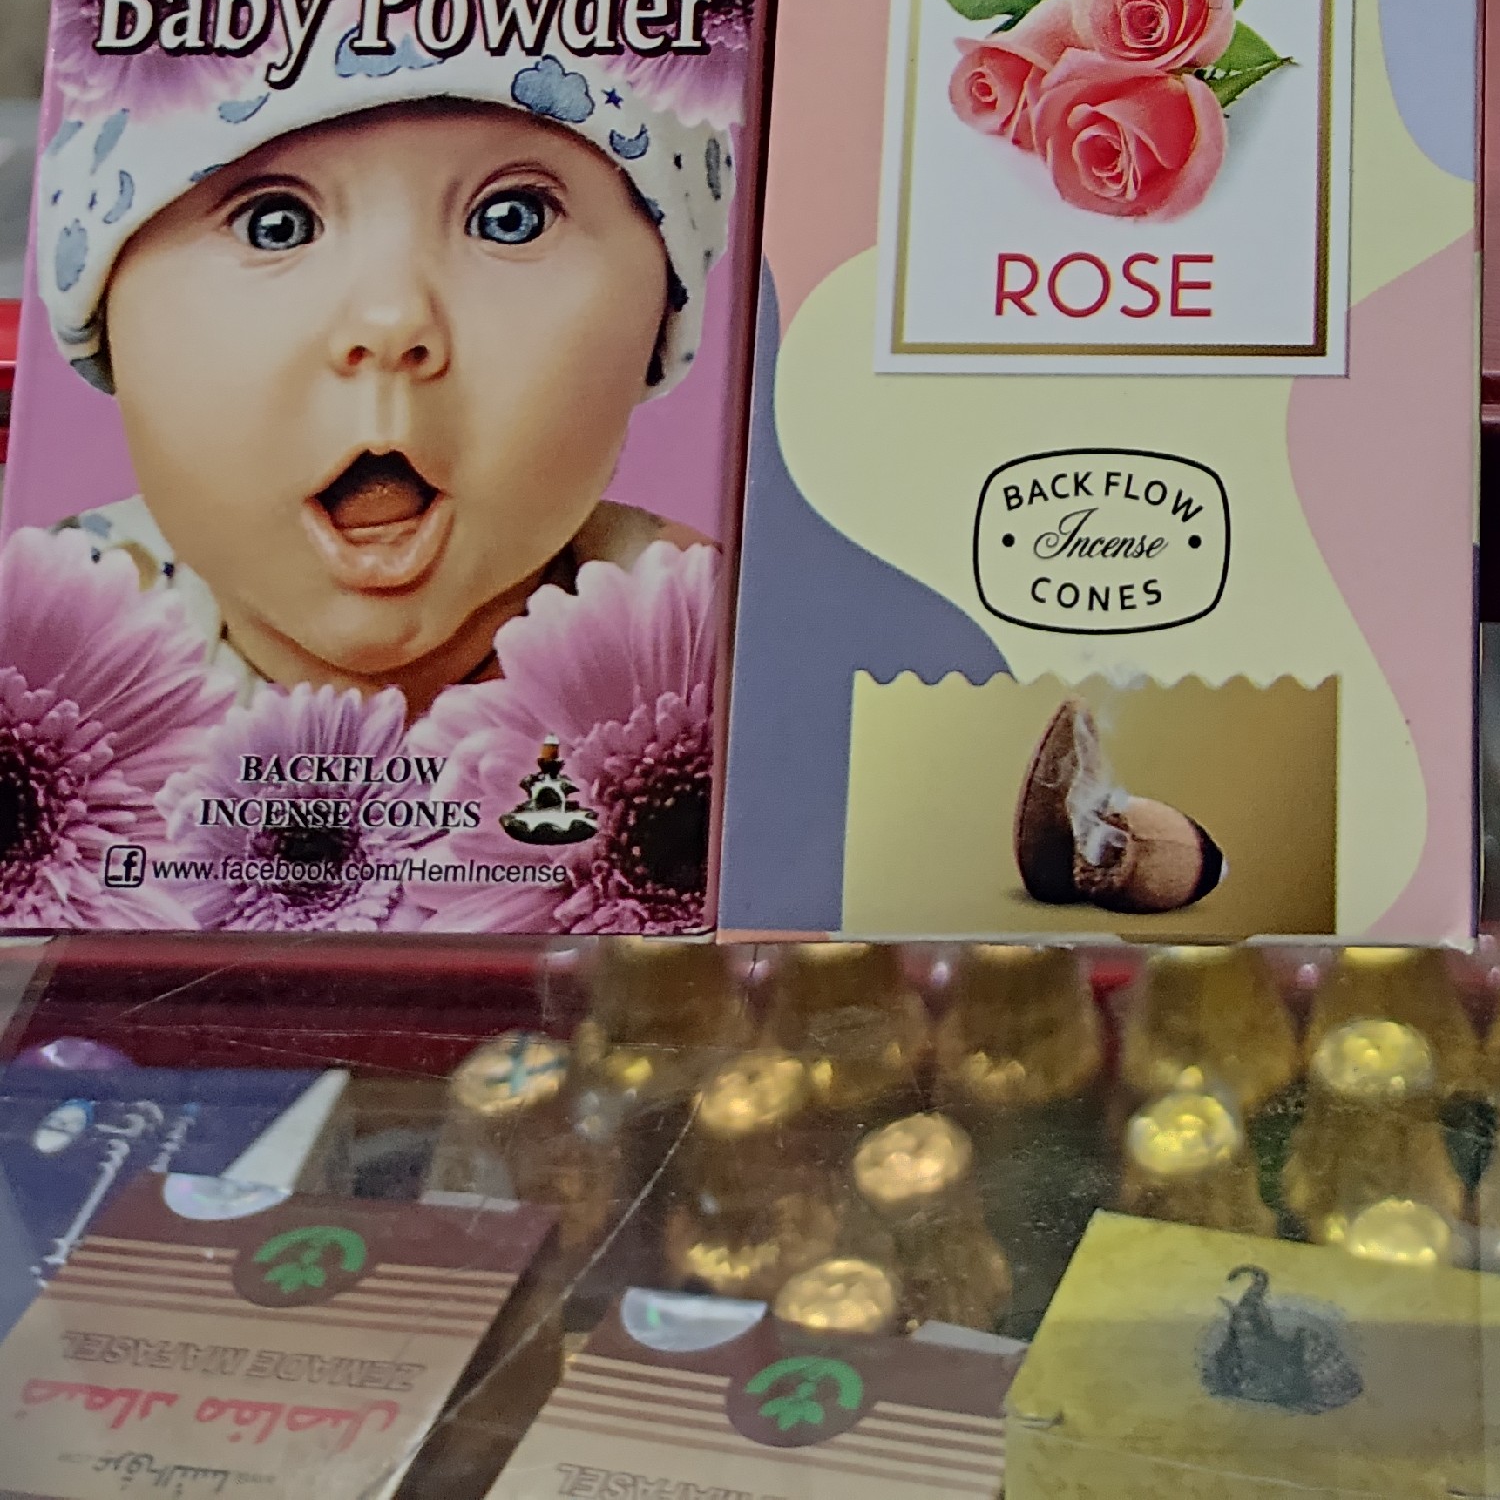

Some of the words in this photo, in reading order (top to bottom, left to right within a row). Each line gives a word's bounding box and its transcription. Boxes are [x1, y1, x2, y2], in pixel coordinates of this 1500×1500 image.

[993, 251, 1214, 319] ROSE
[1003, 470, 1093, 512] BACK
[1103, 470, 1204, 524] FLOW
[1033, 507, 1170, 561] Incense
[1030, 575, 1163, 613] CONES
[240, 753, 449, 786] BACKFLOW
[199, 796, 354, 830] INCENSE
[359, 798, 482, 831] CONES
[152, 854, 568, 889] www.facebook.com/HemIncense
[62, 1330, 248, 1377] MAFASEL
[247, 1349, 428, 1393] ZEMADE
[15, 1378, 179, 1431] ضماد
[194, 1396, 400, 1452] مفاصل
